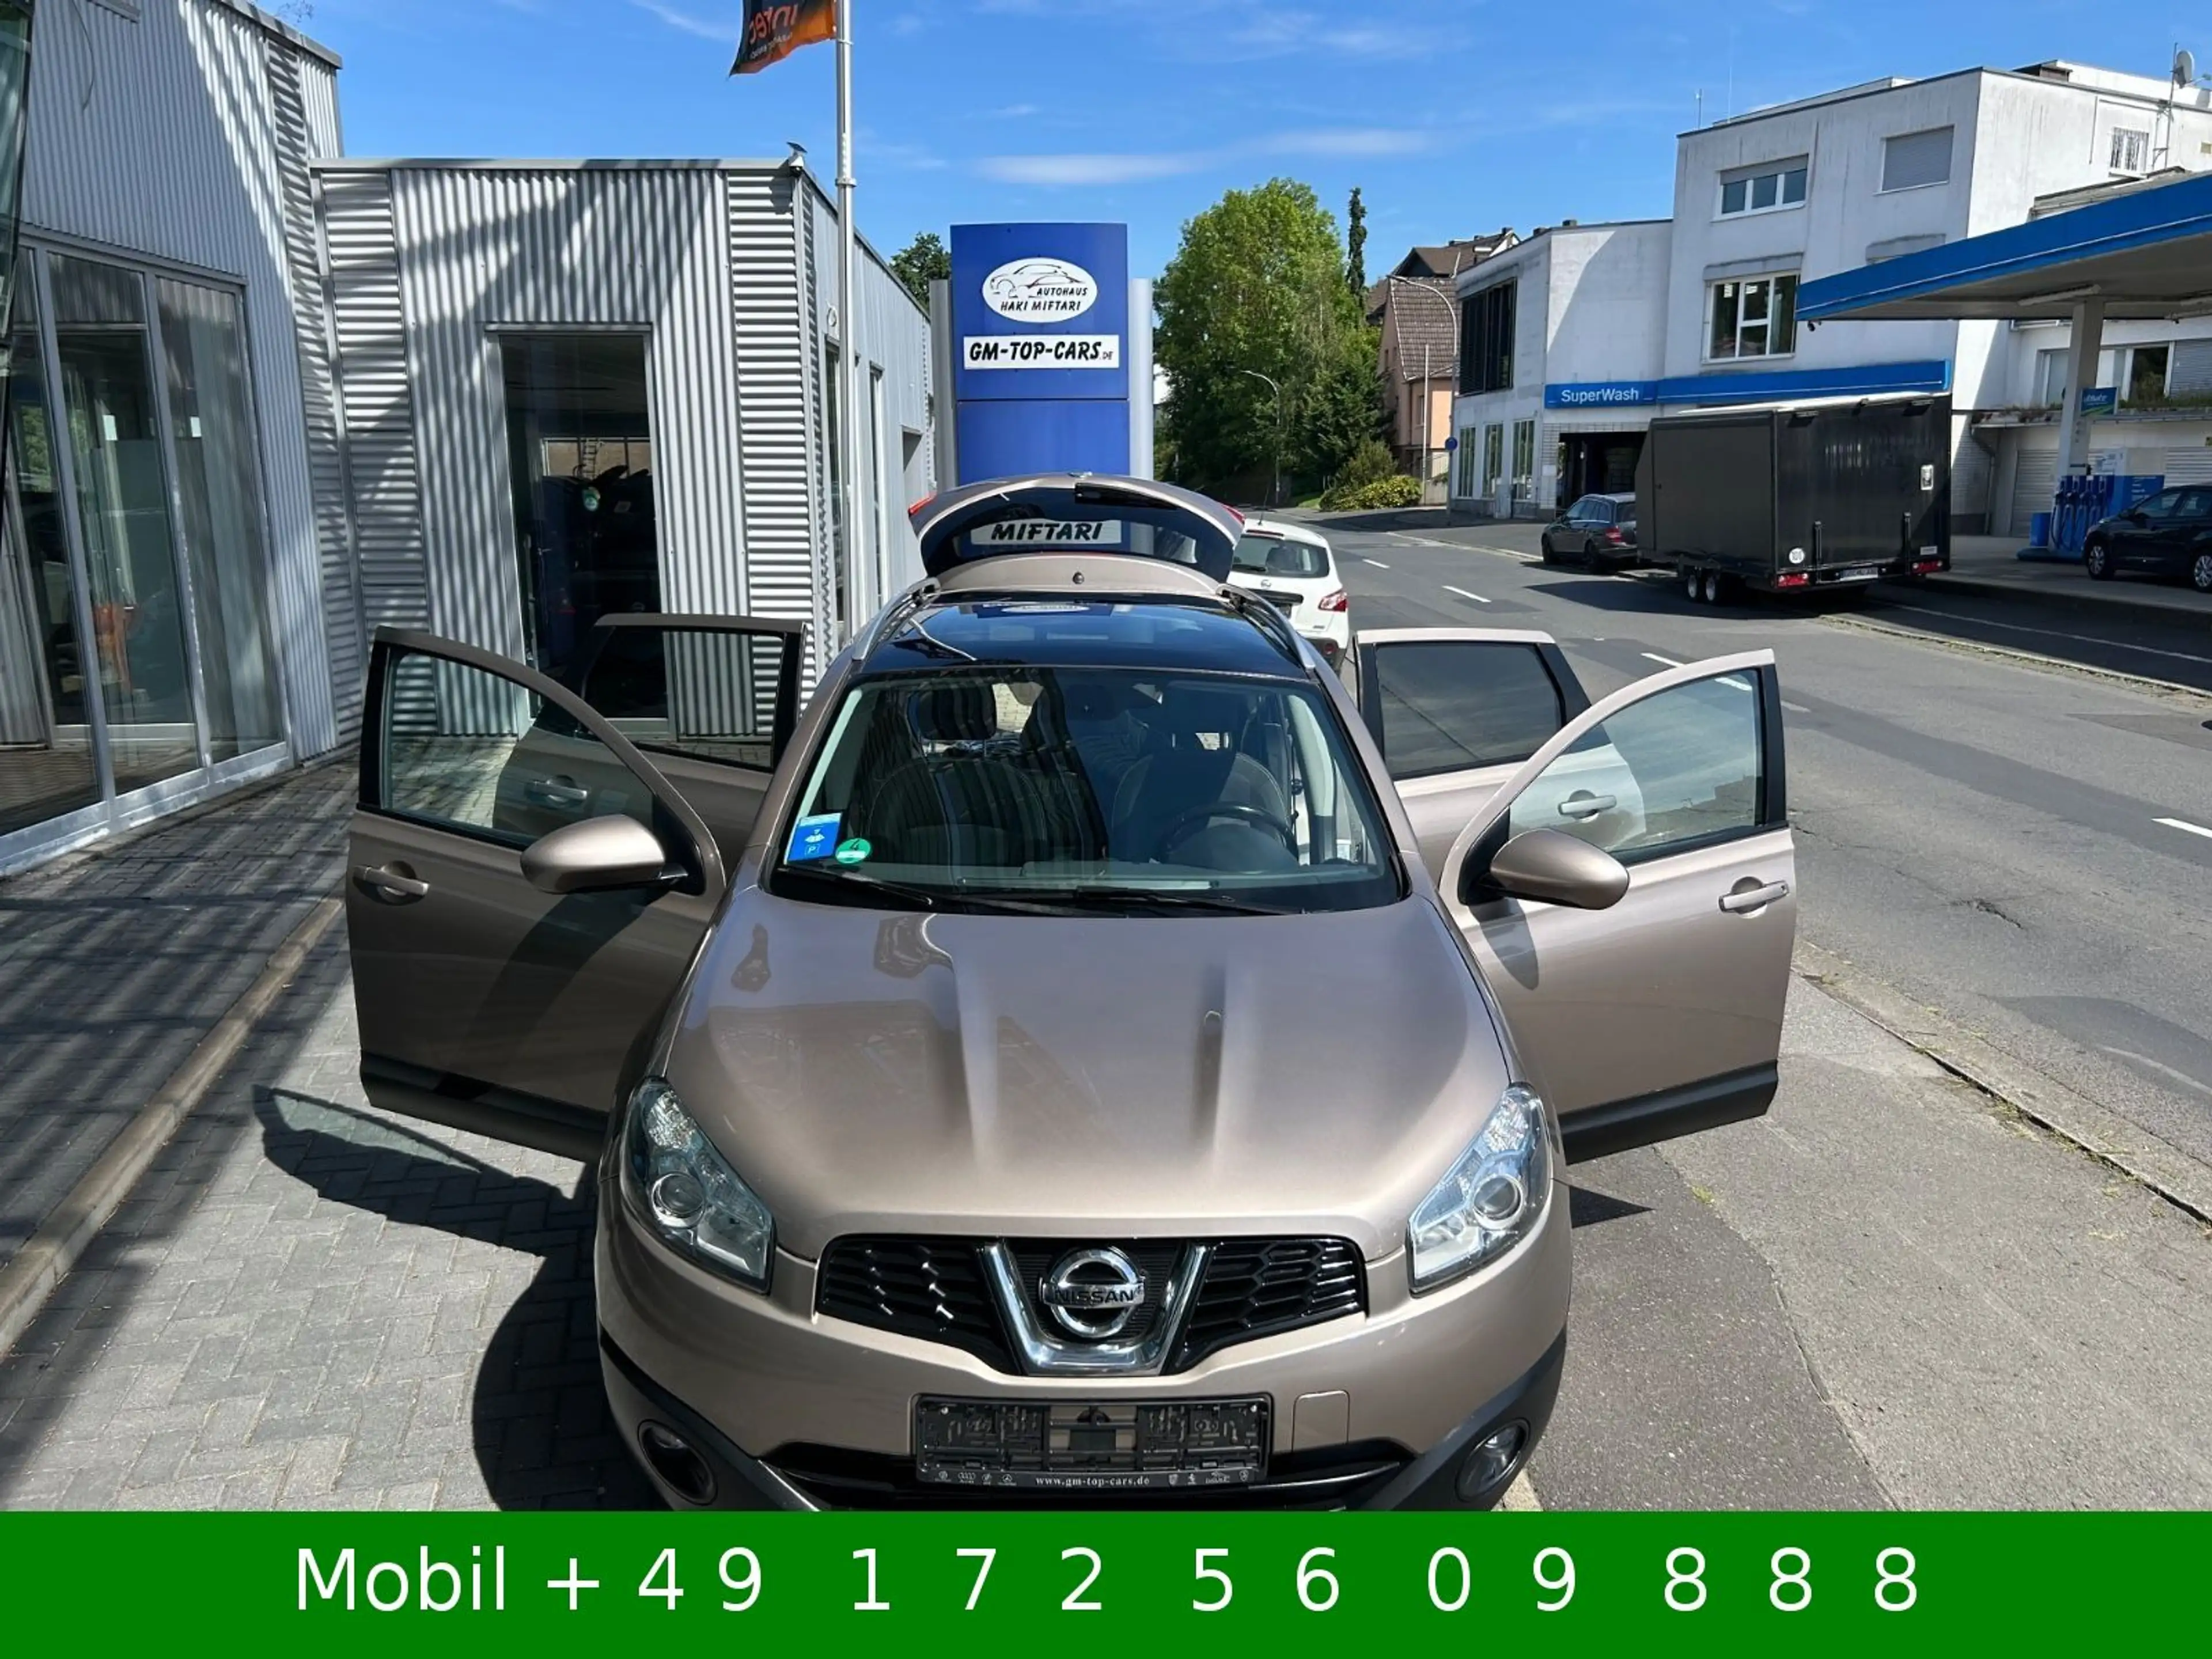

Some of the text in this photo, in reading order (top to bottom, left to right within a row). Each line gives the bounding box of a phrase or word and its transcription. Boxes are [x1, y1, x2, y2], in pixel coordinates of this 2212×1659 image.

[1001, 301, 1081, 311] HAKI MIFTARI
[1561, 388, 1639, 403] SuperWash
[991, 522, 1103, 541] MIFTARI
[1054, 1290, 1134, 1303] NISSAN
[1036, 1476, 1150, 1488] www.gm-top-cars.de
